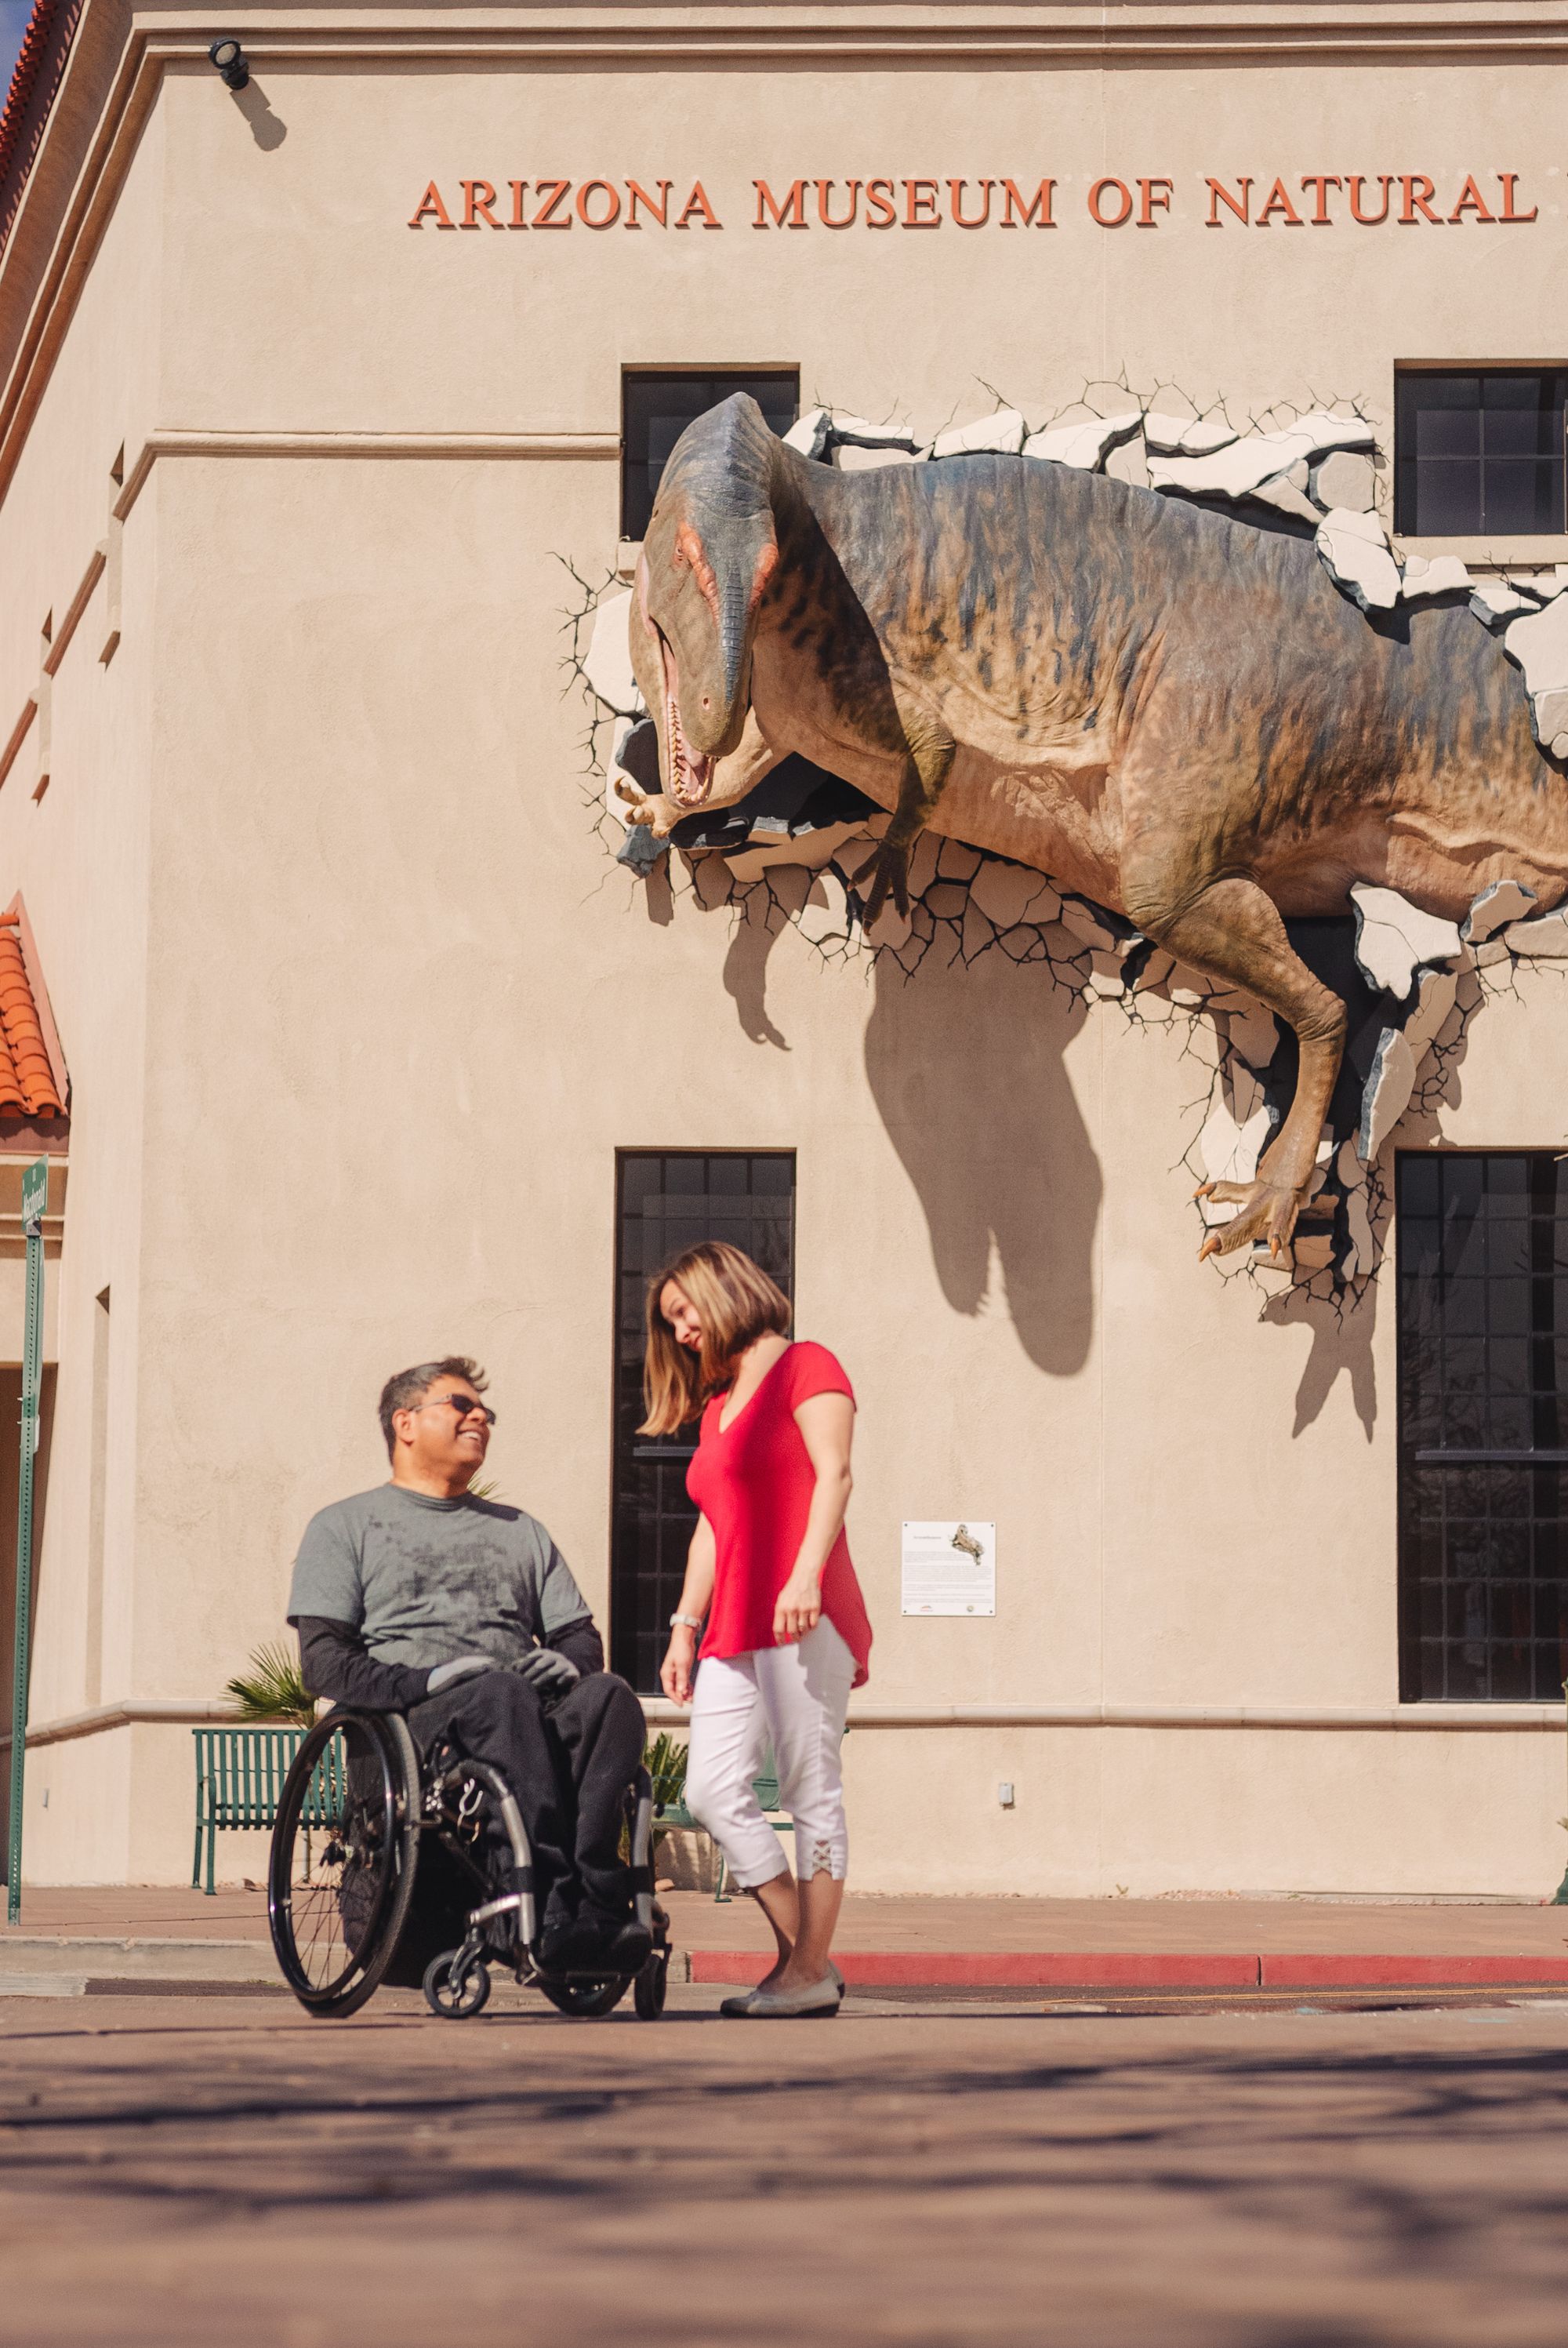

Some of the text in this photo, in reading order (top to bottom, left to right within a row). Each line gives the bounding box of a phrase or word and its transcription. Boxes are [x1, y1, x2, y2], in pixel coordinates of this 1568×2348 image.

[408, 173, 1537, 227] ARIZONA MUSEUM OF NATURAL
